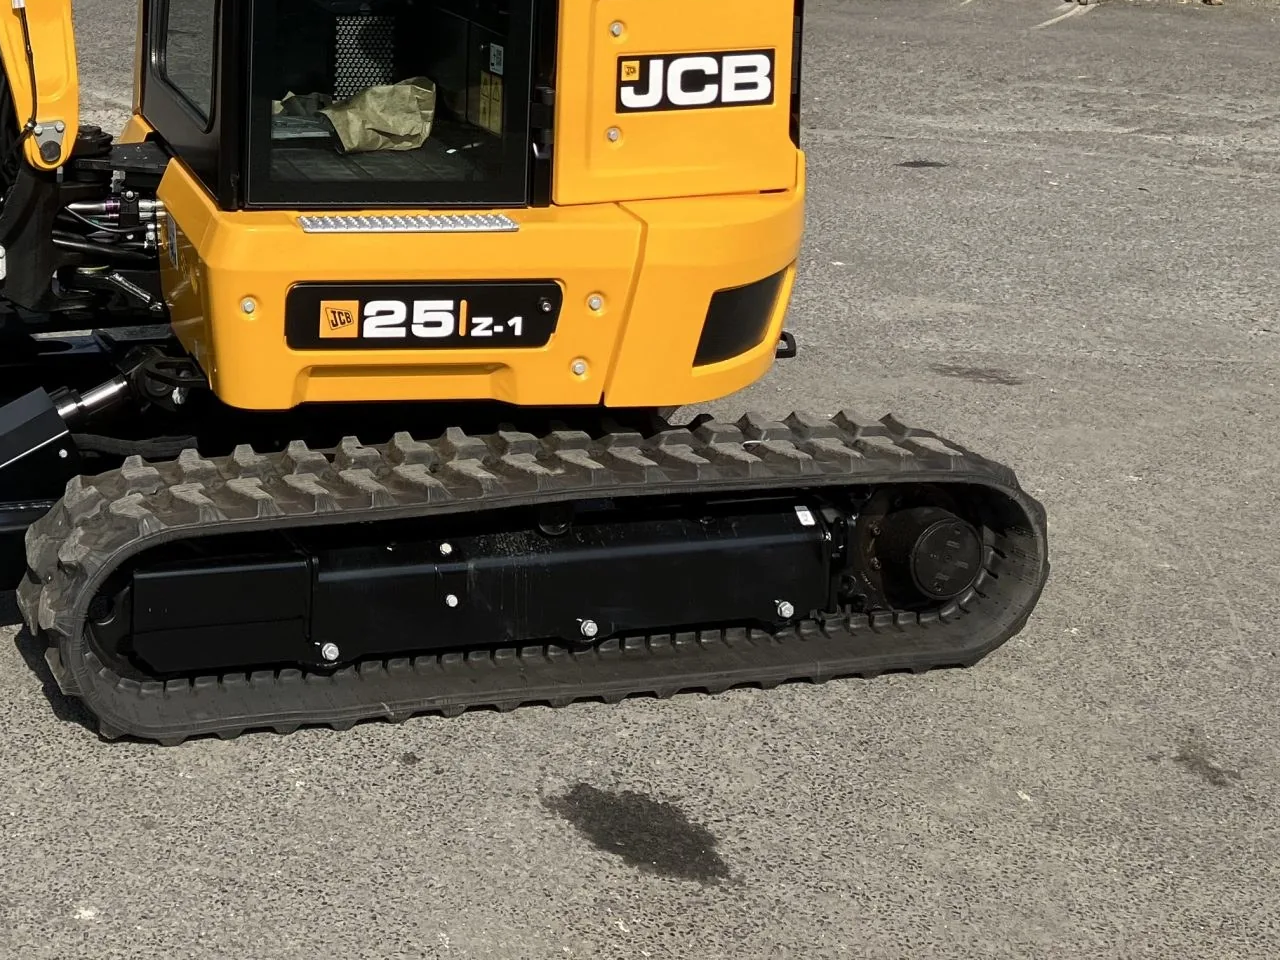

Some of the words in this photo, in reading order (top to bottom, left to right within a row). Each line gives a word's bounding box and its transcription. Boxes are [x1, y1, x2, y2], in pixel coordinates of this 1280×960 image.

[620, 53, 771, 108] JCB
[330, 309, 352, 328] JCB
[362, 299, 455, 338] 25
[470, 316, 523, 337] Z-1
